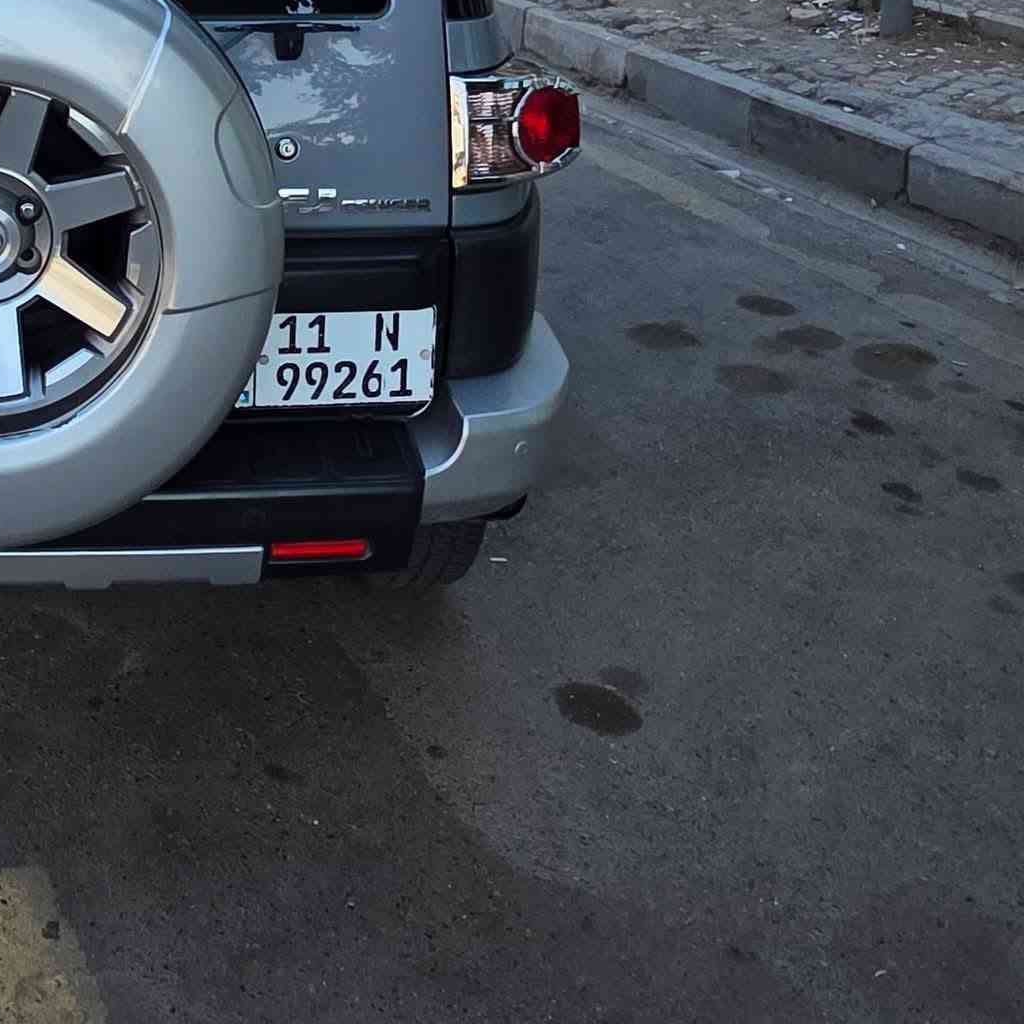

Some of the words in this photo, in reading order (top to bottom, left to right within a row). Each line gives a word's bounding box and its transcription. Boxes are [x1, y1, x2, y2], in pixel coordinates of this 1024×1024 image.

[278, 315, 331, 355] 11
[375, 312, 400, 352] N
[276, 358, 413, 401] 99261
